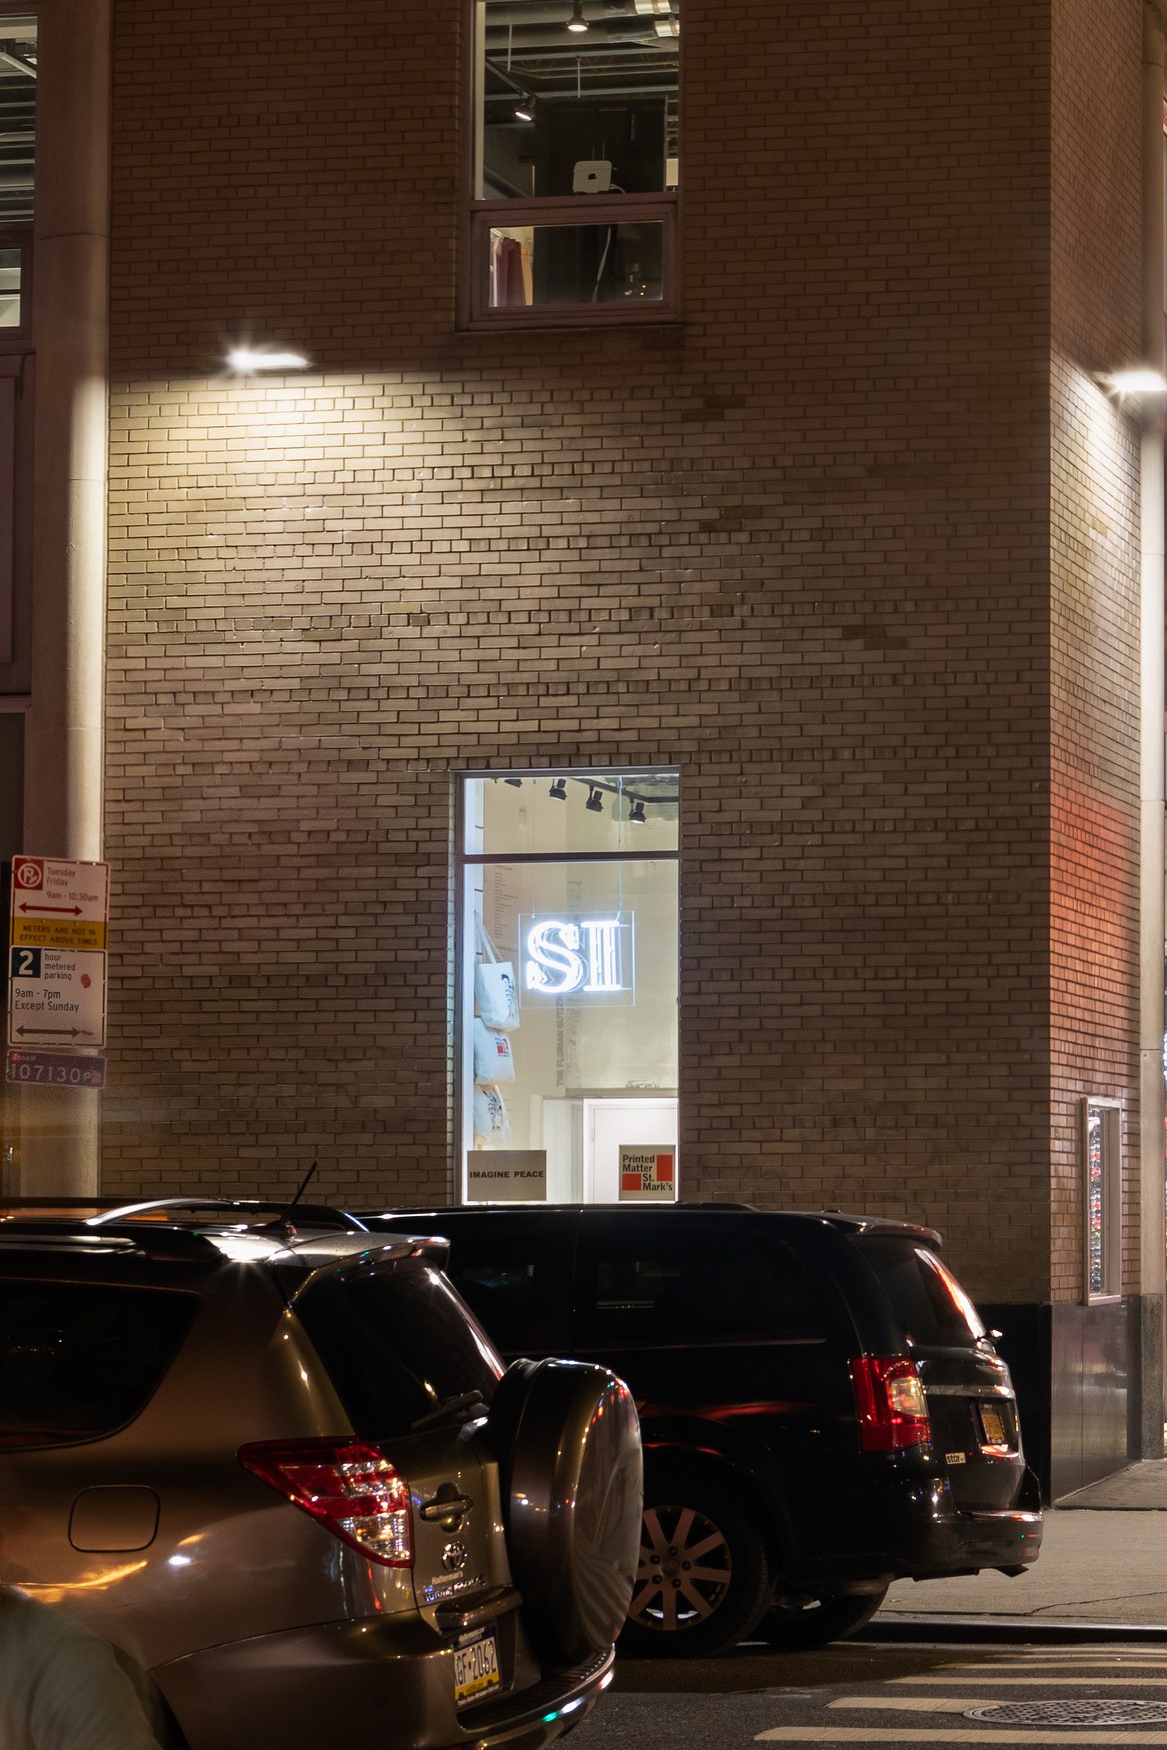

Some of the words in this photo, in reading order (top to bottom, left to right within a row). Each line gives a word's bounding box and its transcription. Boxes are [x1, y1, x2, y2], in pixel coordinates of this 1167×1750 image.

[47, 867, 76, 877] Tuesday
[46, 878, 68, 887] Friday
[46, 891, 61, 900] 9am
[69, 892, 99, 902] 10:30am
[23, 925, 51, 933] METERS
[55, 926, 68, 935] ARE
[20, 934, 46, 942] EFFECT
[50, 936, 75, 944] ABOVE
[44, 953, 62, 961] hour
[527, 920, 626, 993] SI
[19, 950, 33, 975] 2
[44, 963, 76, 971] metered
[44, 972, 72, 981] parking
[15, 988, 34, 998] 9am
[43, 989, 61, 999] 7pm
[15, 1000, 45, 1011] Except
[48, 1001, 80, 1013] Sunday
[622, 1155, 655, 1163] Printed
[622, 1164, 653, 1172] Matter
[469, 1170, 510, 1179] IMAGINE
[514, 1170, 544, 1178] PEACE
[642, 1173, 655, 1182] St.
[642, 1183, 673, 1191] Mark's
